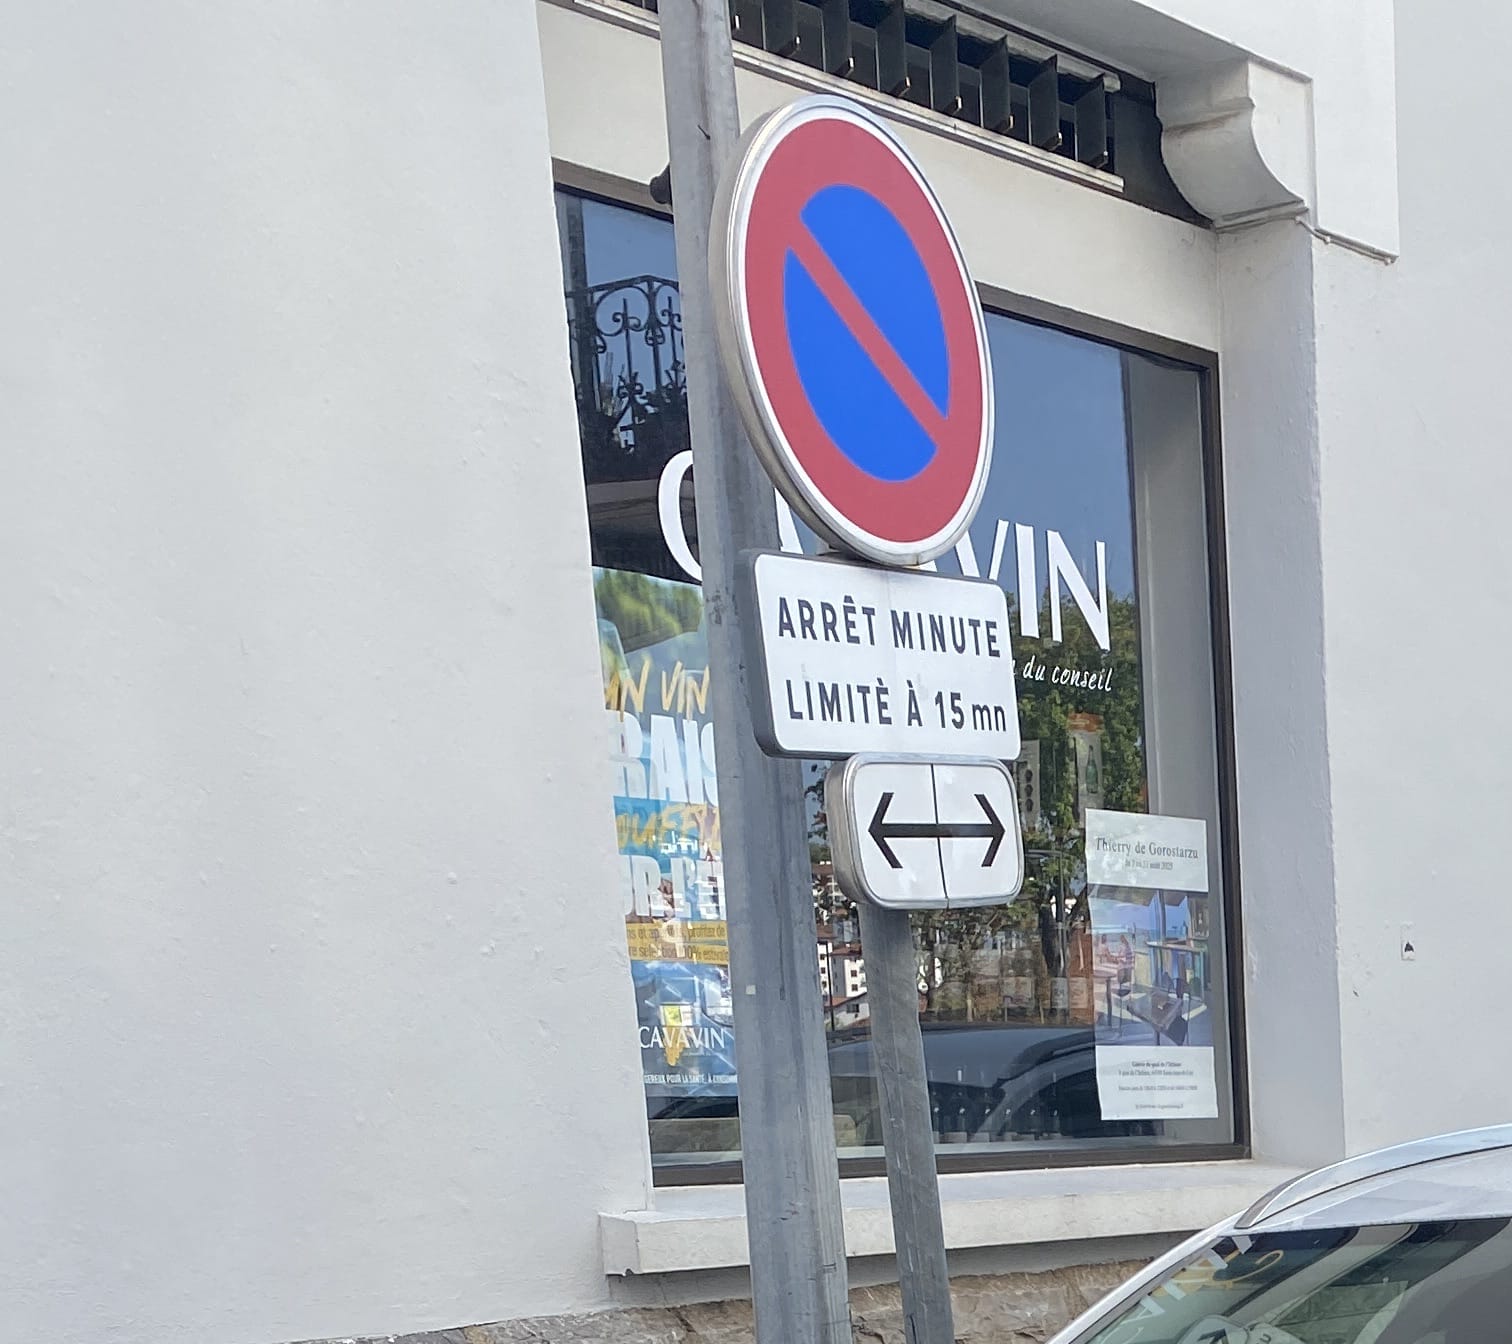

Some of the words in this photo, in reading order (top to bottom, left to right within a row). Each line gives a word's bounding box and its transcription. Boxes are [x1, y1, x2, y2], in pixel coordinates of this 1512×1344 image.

[778, 594, 876, 646] ARRÊT
[890, 609, 1001, 658] MINUTE
[661, 661, 710, 718] VIN
[1022, 654, 1046, 681] du
[1051, 665, 1113, 692] conseil
[785, 677, 893, 726] LIMITÈ
[906, 679, 923, 727] À
[1095, 837, 1131, 857] Thierry
[1134, 841, 1146, 855] de
[638, 1025, 726, 1049] CAVAVIN
